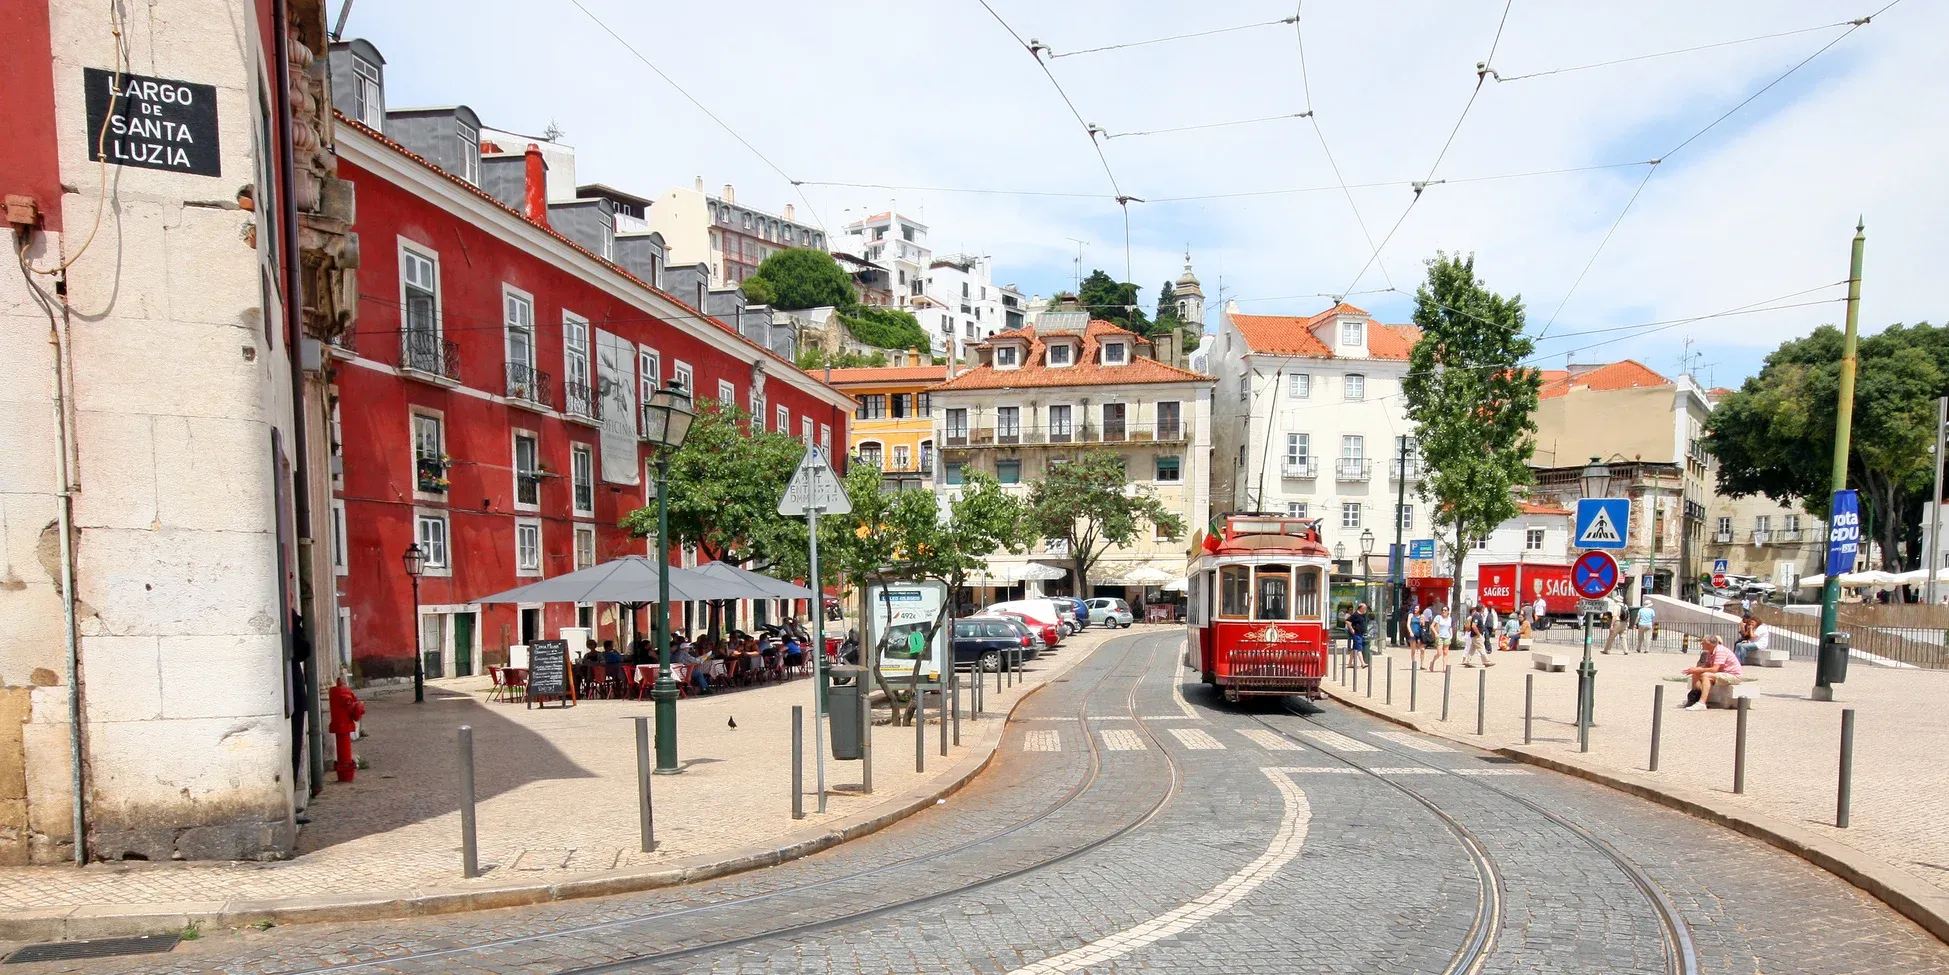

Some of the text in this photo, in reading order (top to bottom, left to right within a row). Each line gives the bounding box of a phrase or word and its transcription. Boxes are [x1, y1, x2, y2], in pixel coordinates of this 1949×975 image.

[108, 76, 193, 106] LARGO
[142, 103, 163, 116] DE
[111, 115, 194, 144] SANTA
[114, 140, 191, 168] LUZIA
[1830, 526, 1859, 542] CDU
[1483, 587, 1510, 597] SAGRES
[1546, 578, 1581, 596] SAGR
